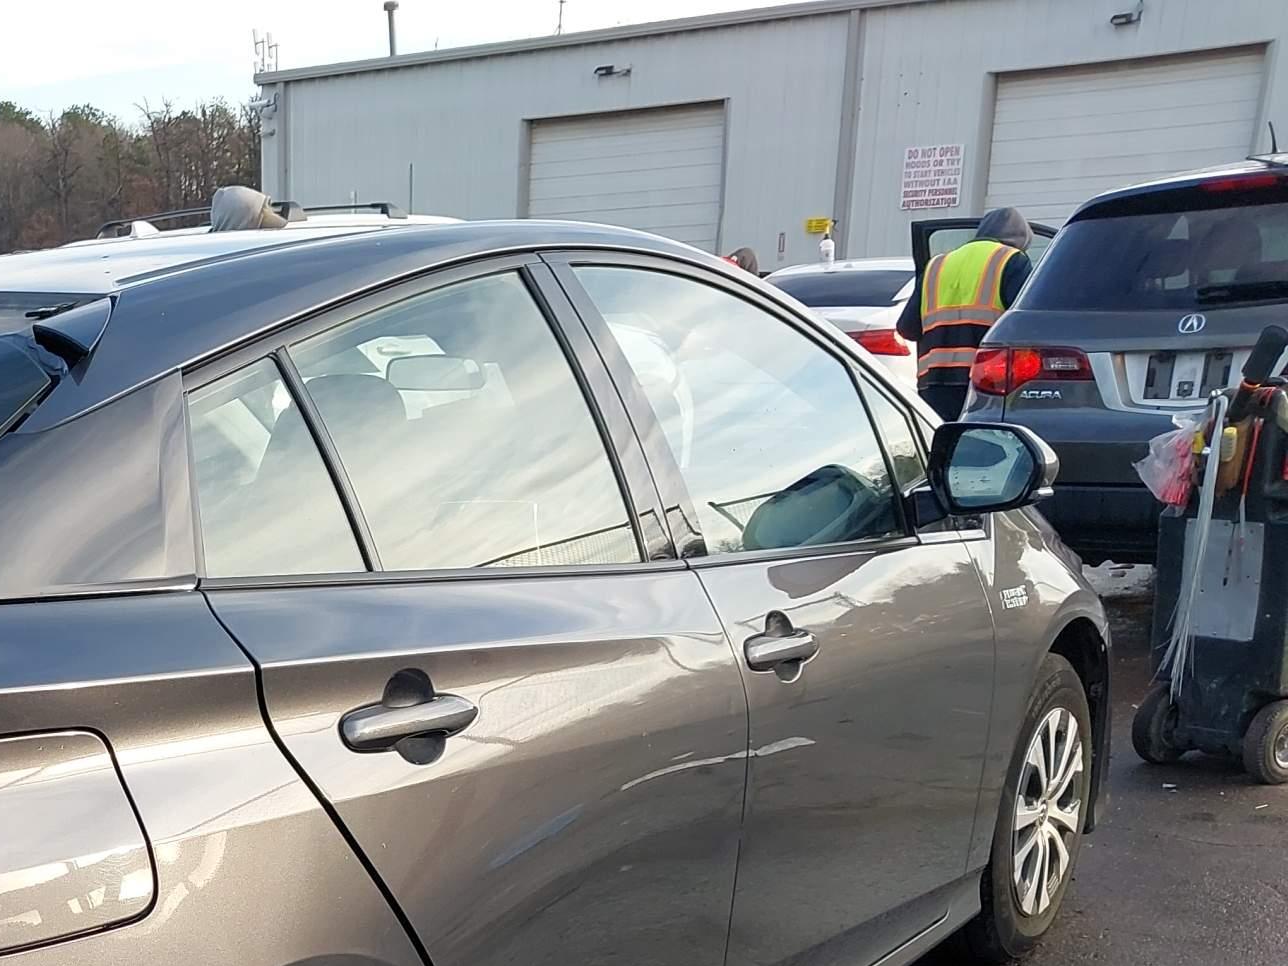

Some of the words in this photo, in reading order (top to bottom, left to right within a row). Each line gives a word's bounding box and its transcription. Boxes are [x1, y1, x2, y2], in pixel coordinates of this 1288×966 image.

[908, 149, 919, 160] DO
[921, 147, 937, 159] NOT
[939, 146, 961, 158] OPEN
[906, 160, 931, 169] HOODS
[933, 159, 944, 167] OR
[946, 158, 961, 167] TRY
[904, 170, 912, 179] TO
[913, 169, 932, 178] START
[934, 168, 960, 177] VEHICLES
[904, 179, 941, 188] WITHOUT
[943, 177, 958, 186] IAA
[903, 189, 928, 198] SECURITY
[928, 187, 958, 197] PERSONNEL
[902, 197, 957, 208] AUTHORIZATION
[1020, 390, 1062, 400] ACURA
